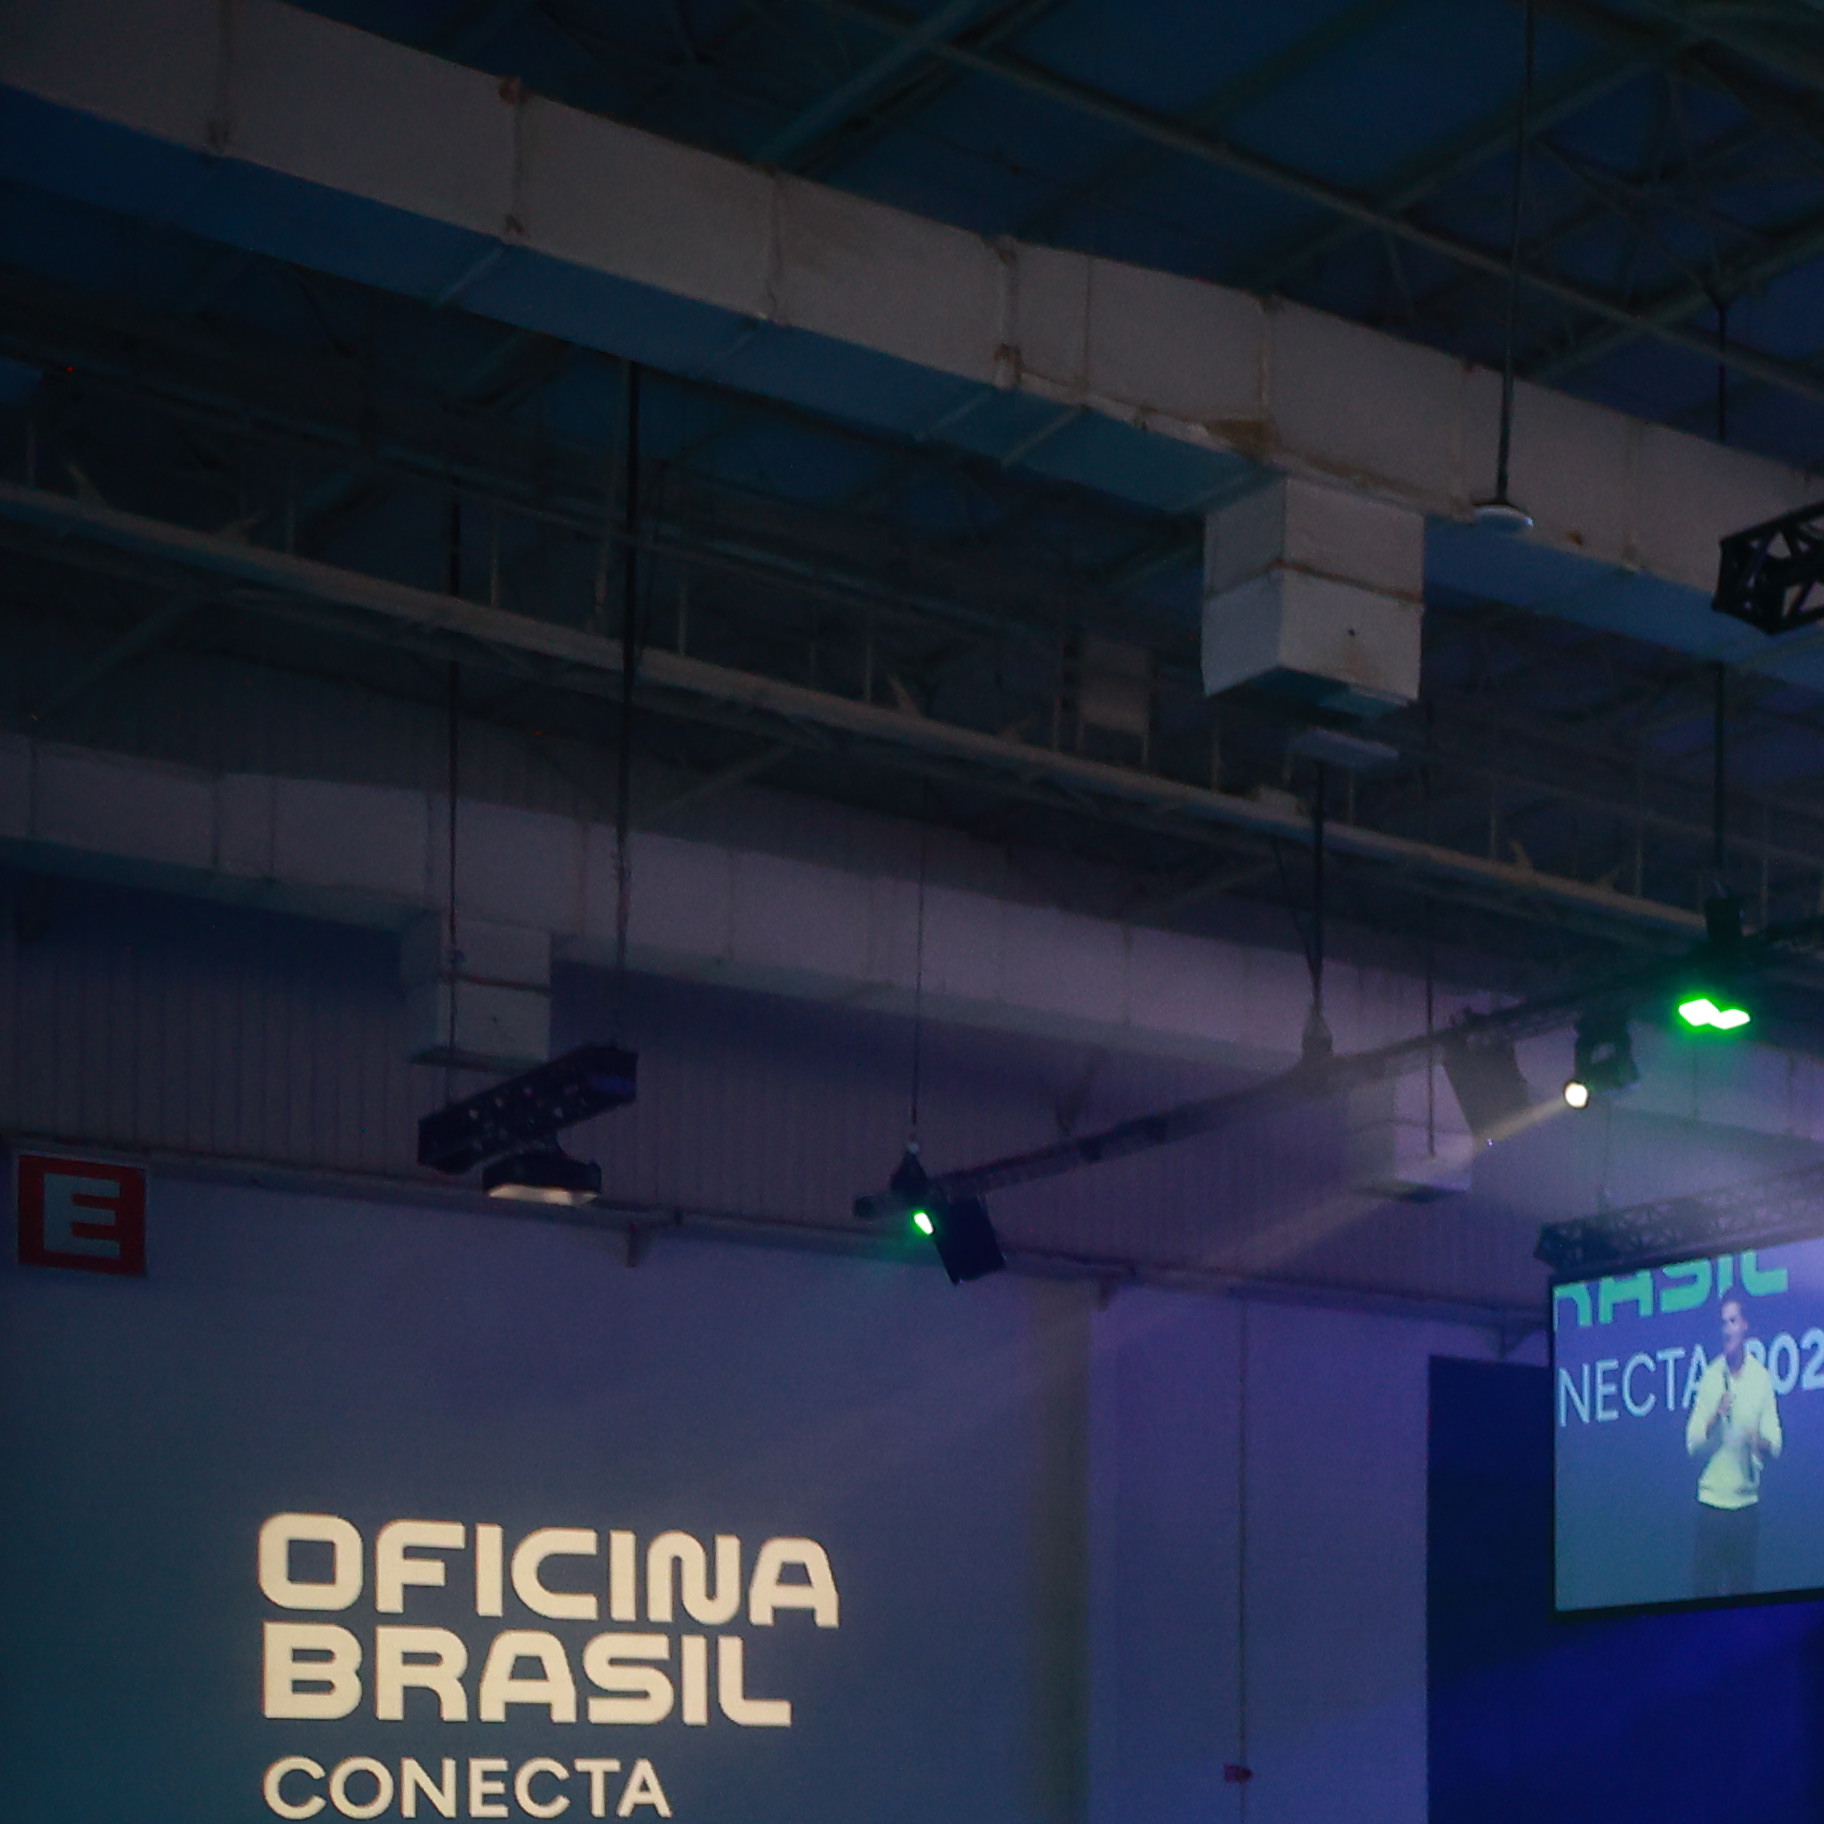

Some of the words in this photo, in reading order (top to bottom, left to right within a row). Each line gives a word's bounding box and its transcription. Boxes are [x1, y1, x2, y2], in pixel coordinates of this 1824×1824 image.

[43, 1173, 121, 1257] E
[257, 1511, 840, 1629] OFICINA
[262, 1620, 792, 1728] BRASIL
[262, 1754, 673, 1821] CONECTA
